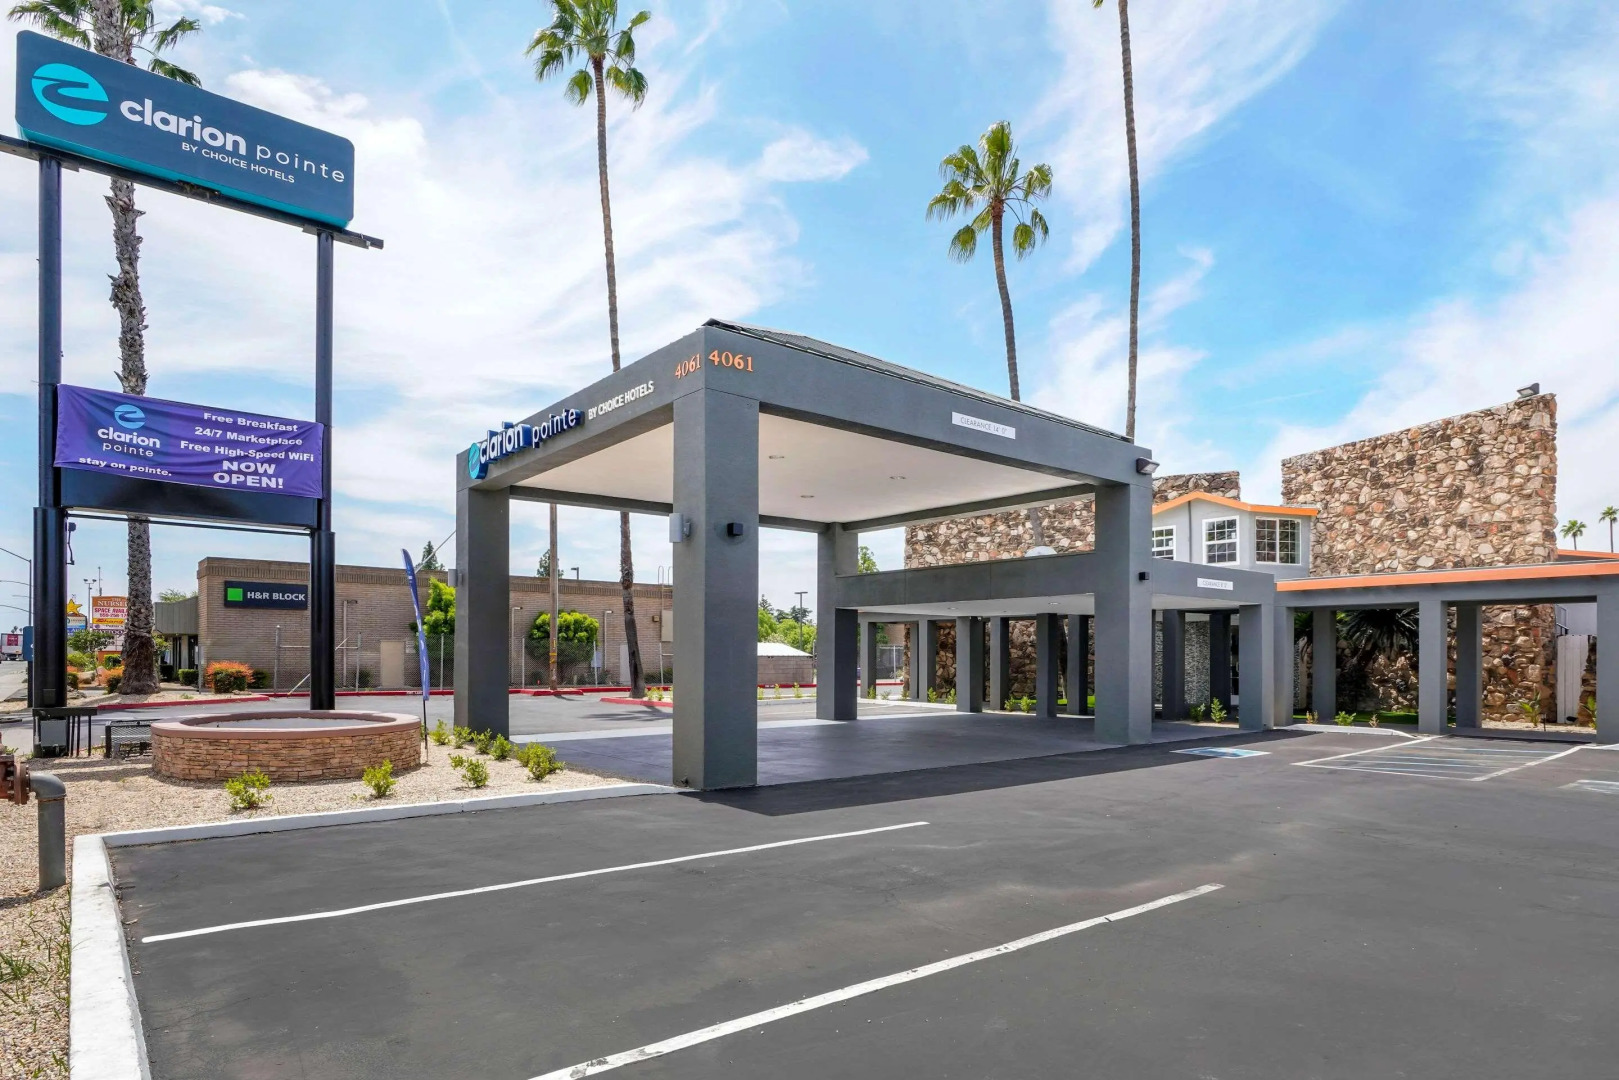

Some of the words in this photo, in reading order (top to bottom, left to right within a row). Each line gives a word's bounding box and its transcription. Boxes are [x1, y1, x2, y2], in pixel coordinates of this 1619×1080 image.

[120, 98, 247, 156] clarion
[256, 143, 345, 183] pointe
[182, 142, 198, 154] BY
[202, 148, 248, 170] CHOICE
[250, 162, 295, 184] HOTELS
[674, 353, 702, 380] 4061
[708, 350, 754, 372] 4061
[588, 407, 597, 420] BY
[598, 394, 624, 416] CHOICE
[624, 380, 654, 404] HOTELS
[204, 412, 234, 424] Free
[238, 417, 298, 432] Breakfast
[960, 416, 991, 431] CLEARANCE
[98, 426, 160, 448] clarion
[194, 426, 223, 438] 24/7
[226, 432, 302, 446] Marketplace
[479, 422, 526, 464] clarion
[532, 407, 577, 448] pointe
[103, 441, 154, 458] pointe
[180, 440, 210, 452] Free
[214, 445, 285, 460] High-Speed
[288, 451, 314, 462] WiFi
[79, 456, 107, 468] stay
[110, 460, 126, 469] on
[130, 463, 172, 476] pointe.
[222, 460, 276, 474] NOW
[214, 472, 284, 488] OPEN!
[247, 591, 269, 600] H&R
[273, 592, 305, 601] BLOCK
